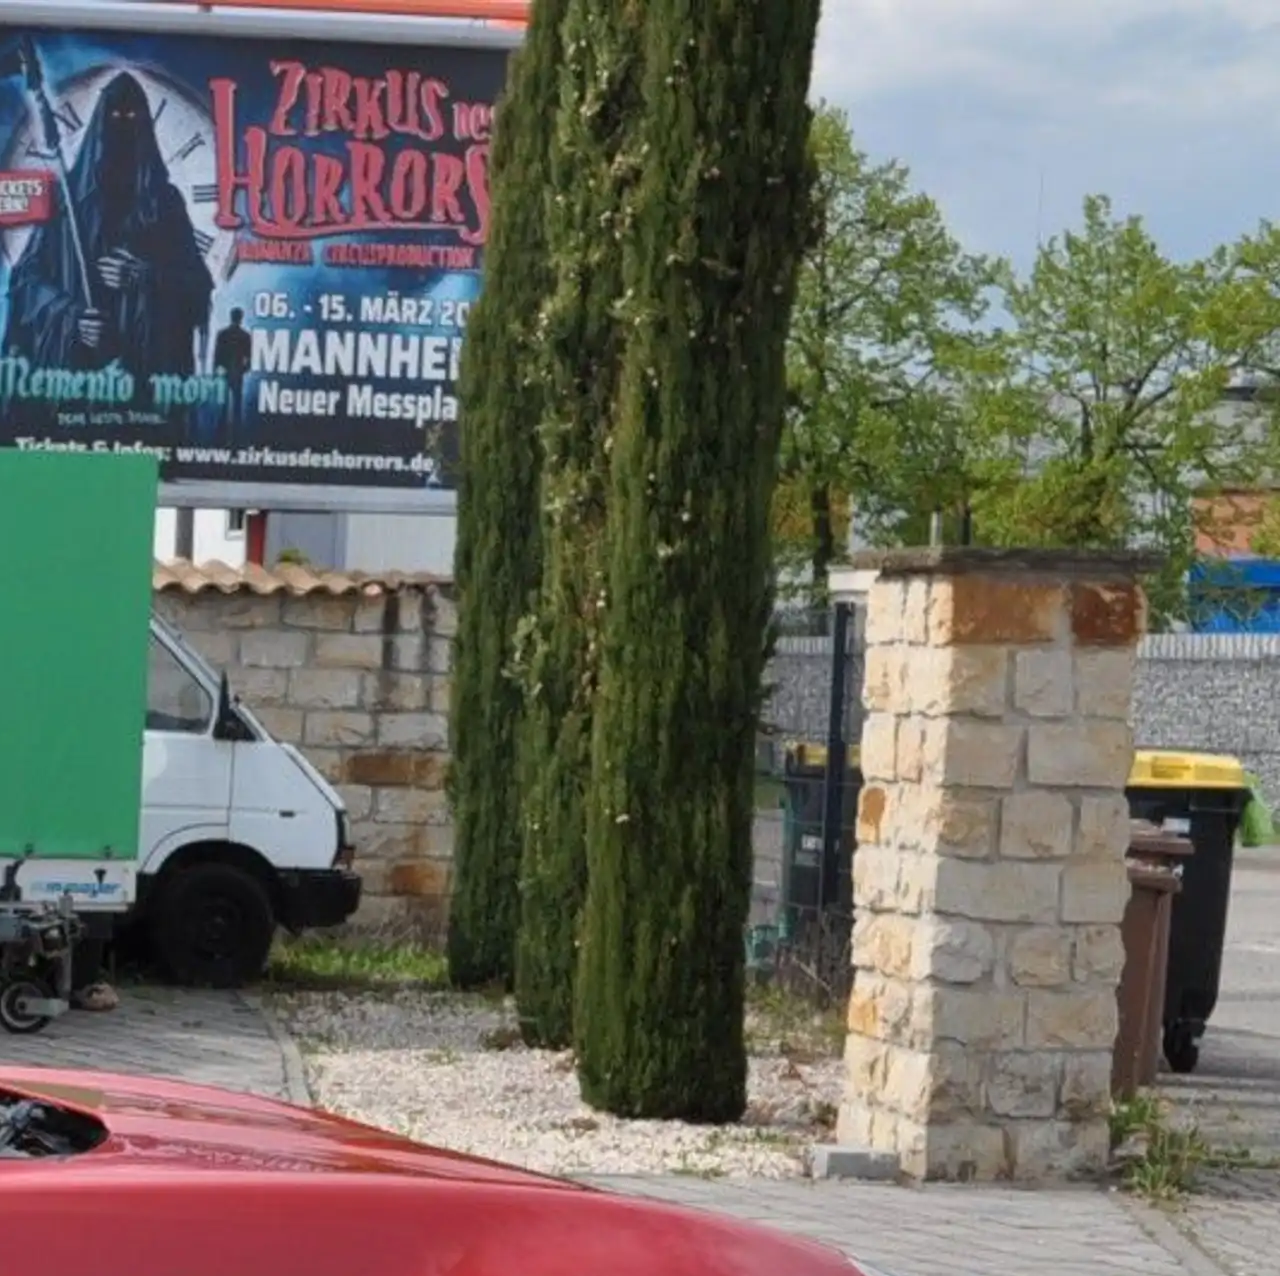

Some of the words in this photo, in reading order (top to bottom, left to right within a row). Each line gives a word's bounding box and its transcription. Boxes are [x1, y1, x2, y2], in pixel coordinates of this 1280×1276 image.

[269, 59, 450, 141] ZIRKUS
[209, 77, 492, 244] HORRORS
[254, 292, 295, 318] 06.
[319, 294, 354, 322] 15.
[360, 292, 432, 325] MÄRZ
[149, 366, 230, 406] mori
[258, 381, 340, 415] Neuer
[176, 447, 434, 472] www.zirkusdeshorrors.de
